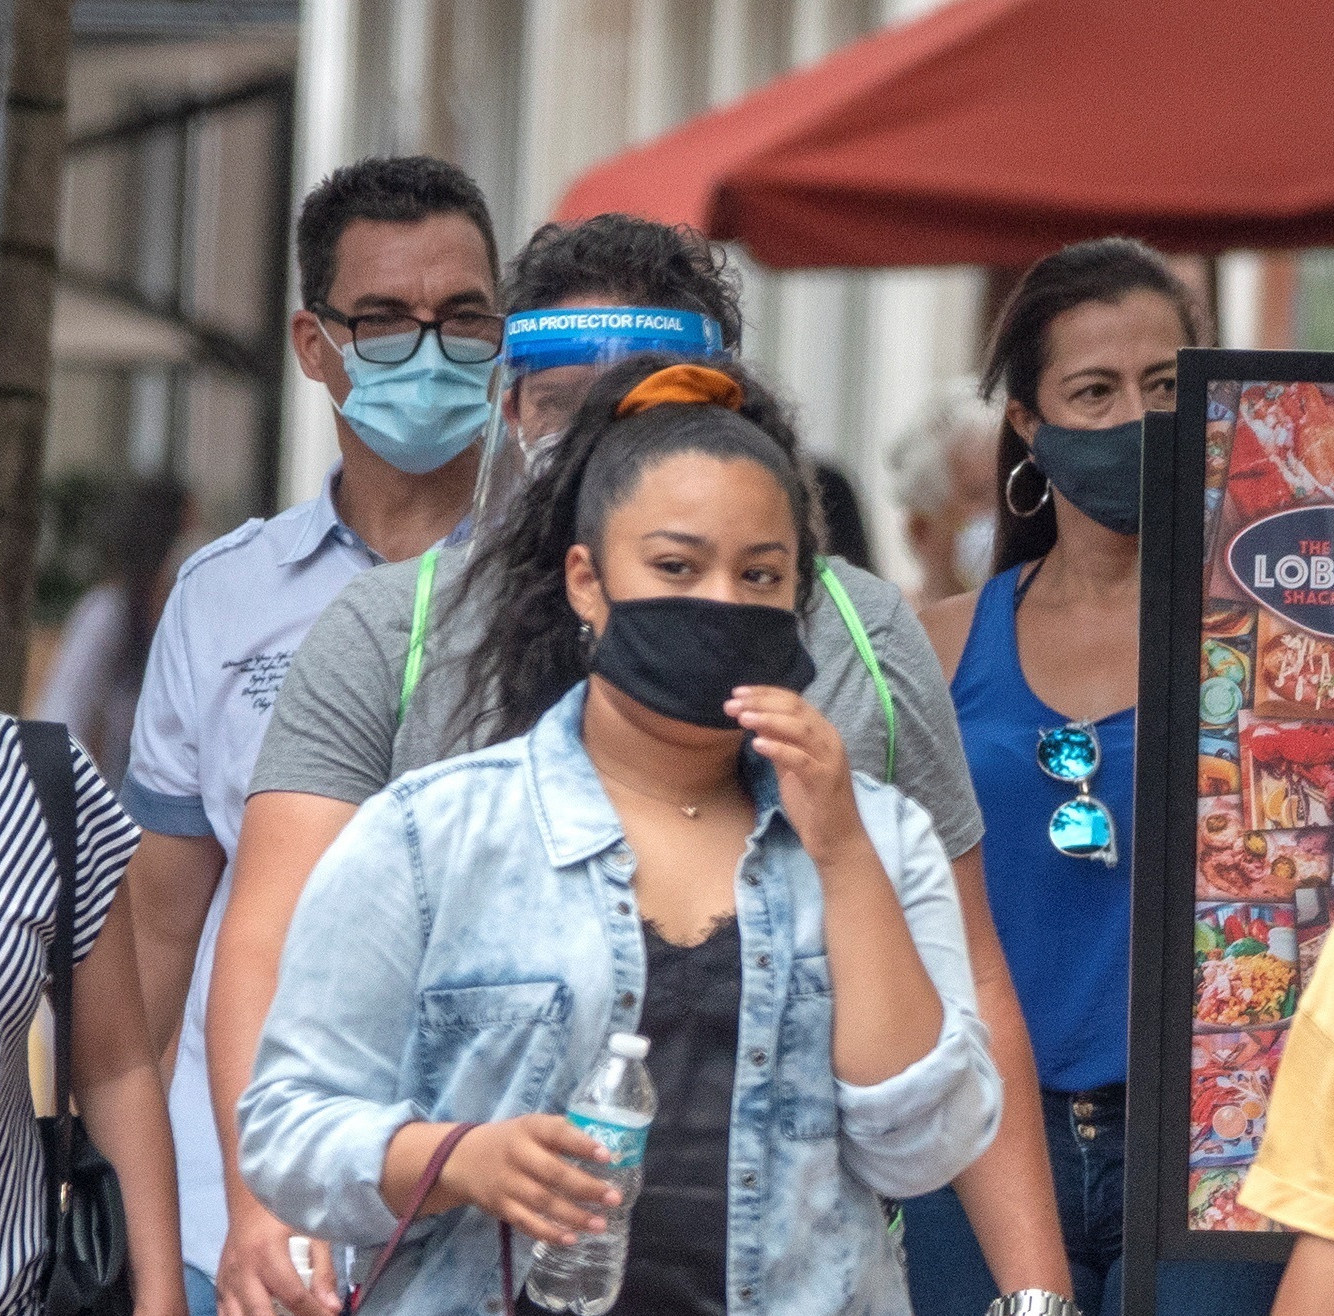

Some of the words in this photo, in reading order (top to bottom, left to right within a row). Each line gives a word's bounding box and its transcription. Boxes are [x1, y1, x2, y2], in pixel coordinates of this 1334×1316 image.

[539, 314, 632, 330] PROTECTOR
[635, 315, 684, 331] FACIAL
[1298, 540, 1331, 556] THE
